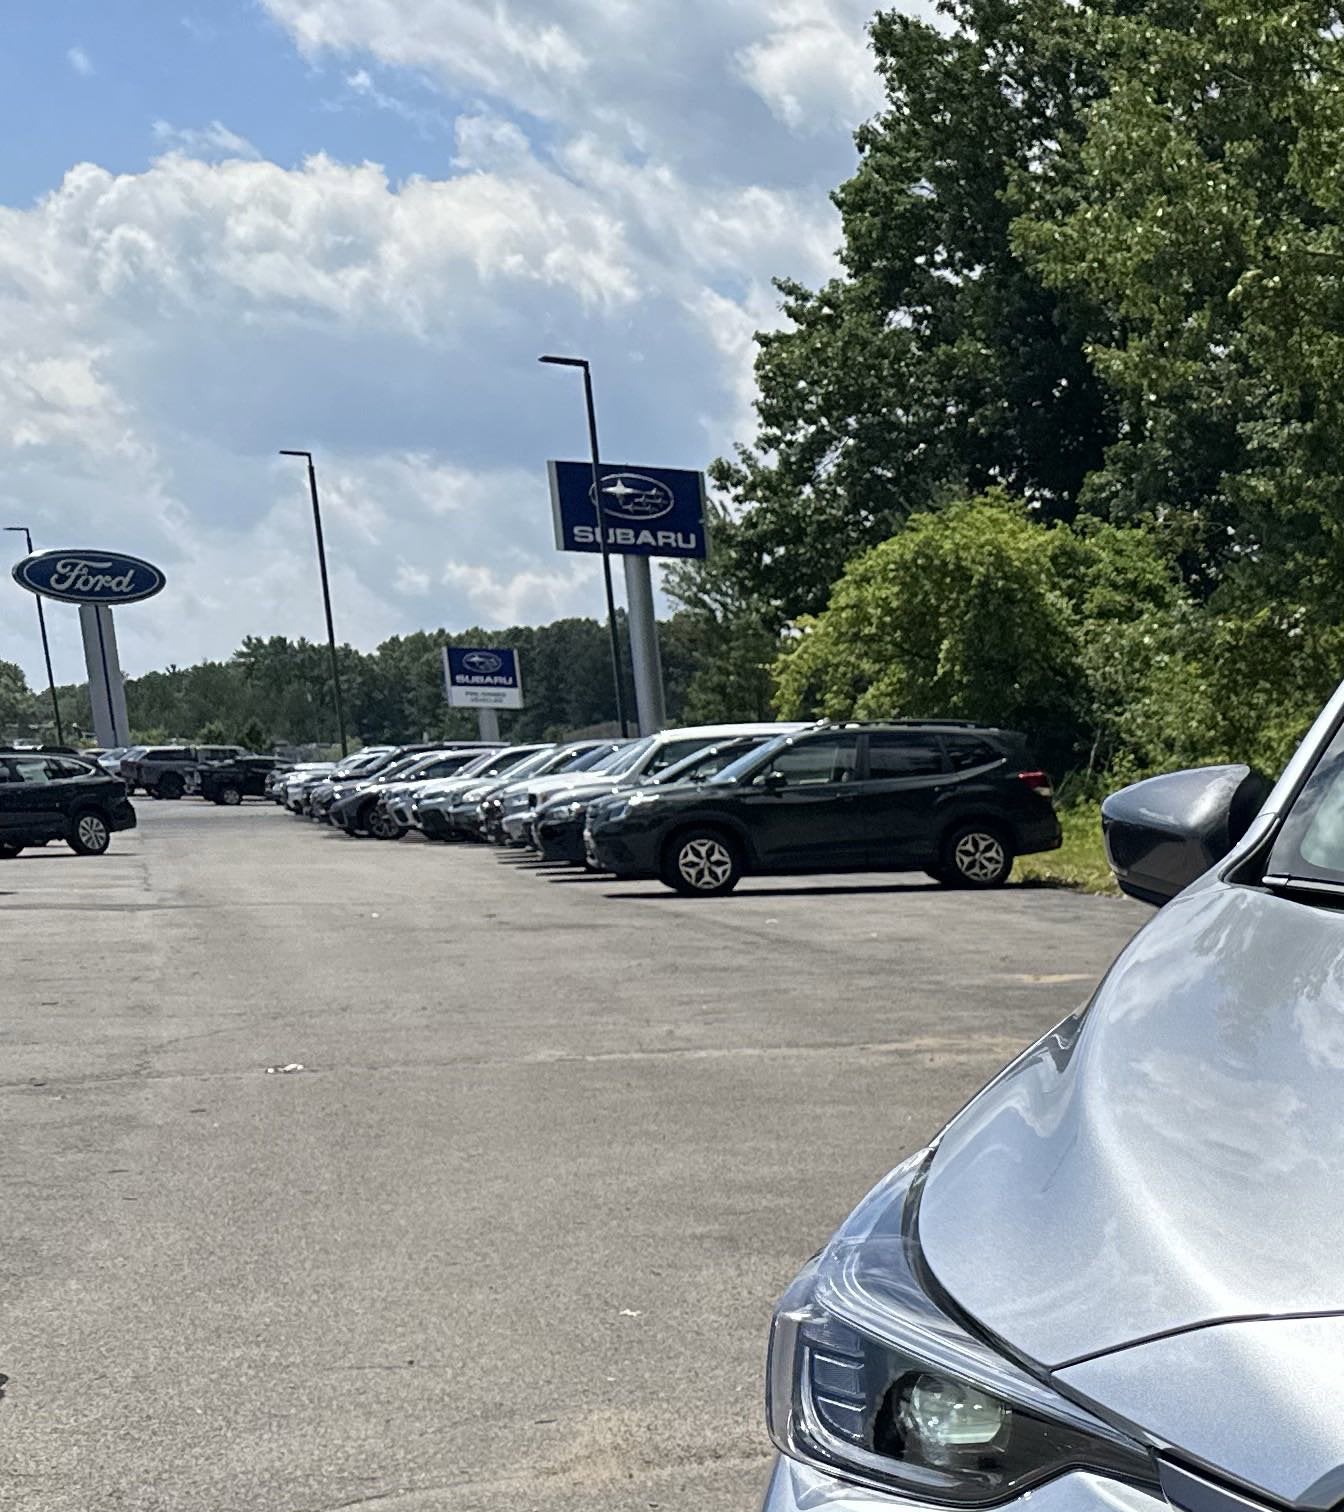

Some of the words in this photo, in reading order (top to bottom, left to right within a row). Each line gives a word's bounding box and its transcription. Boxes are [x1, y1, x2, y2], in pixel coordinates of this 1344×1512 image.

[573, 525, 697, 549] SUBARU
[50, 558, 136, 593] Ford
[455, 673, 513, 686] SUBARU
